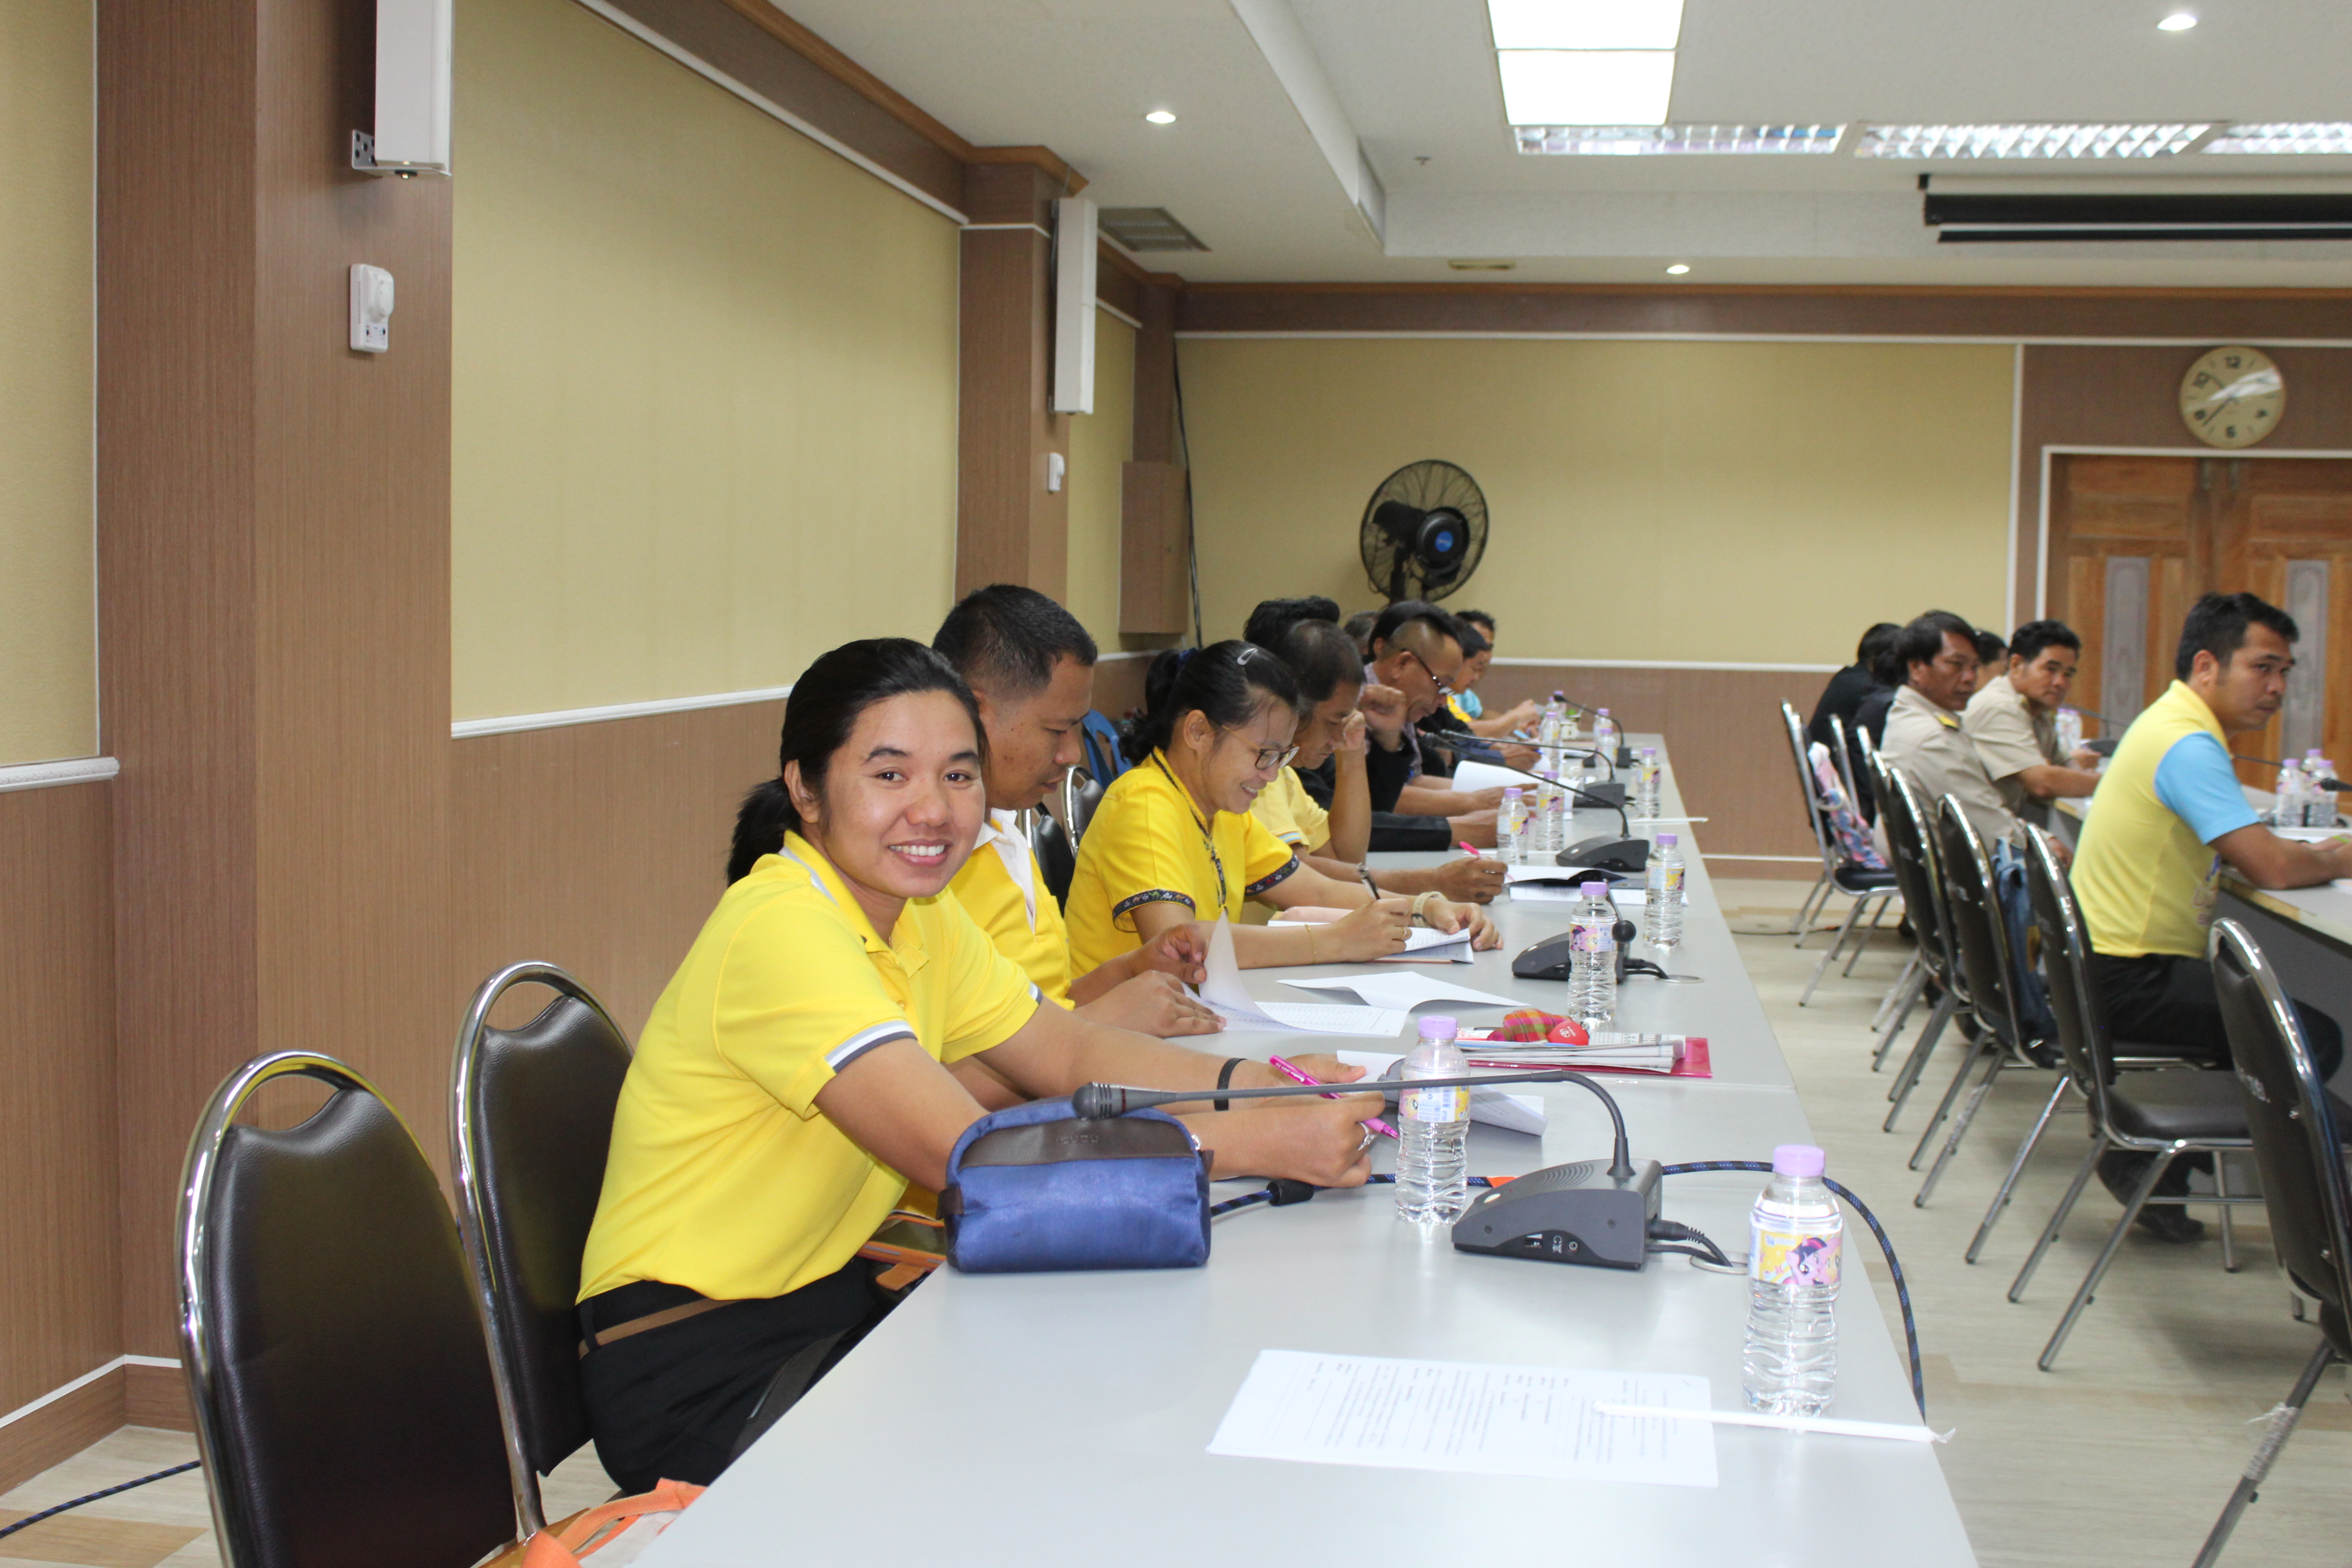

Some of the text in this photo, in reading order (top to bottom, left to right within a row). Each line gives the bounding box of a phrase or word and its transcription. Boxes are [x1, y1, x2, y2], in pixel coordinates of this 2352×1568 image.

[2225, 356, 2241, 368] 12
[2193, 372, 2209, 389] 10
[2195, 409, 2205, 420] 8
[2226, 426, 2236, 438] 6
[1056, 1135, 1098, 1144] ISUZU
